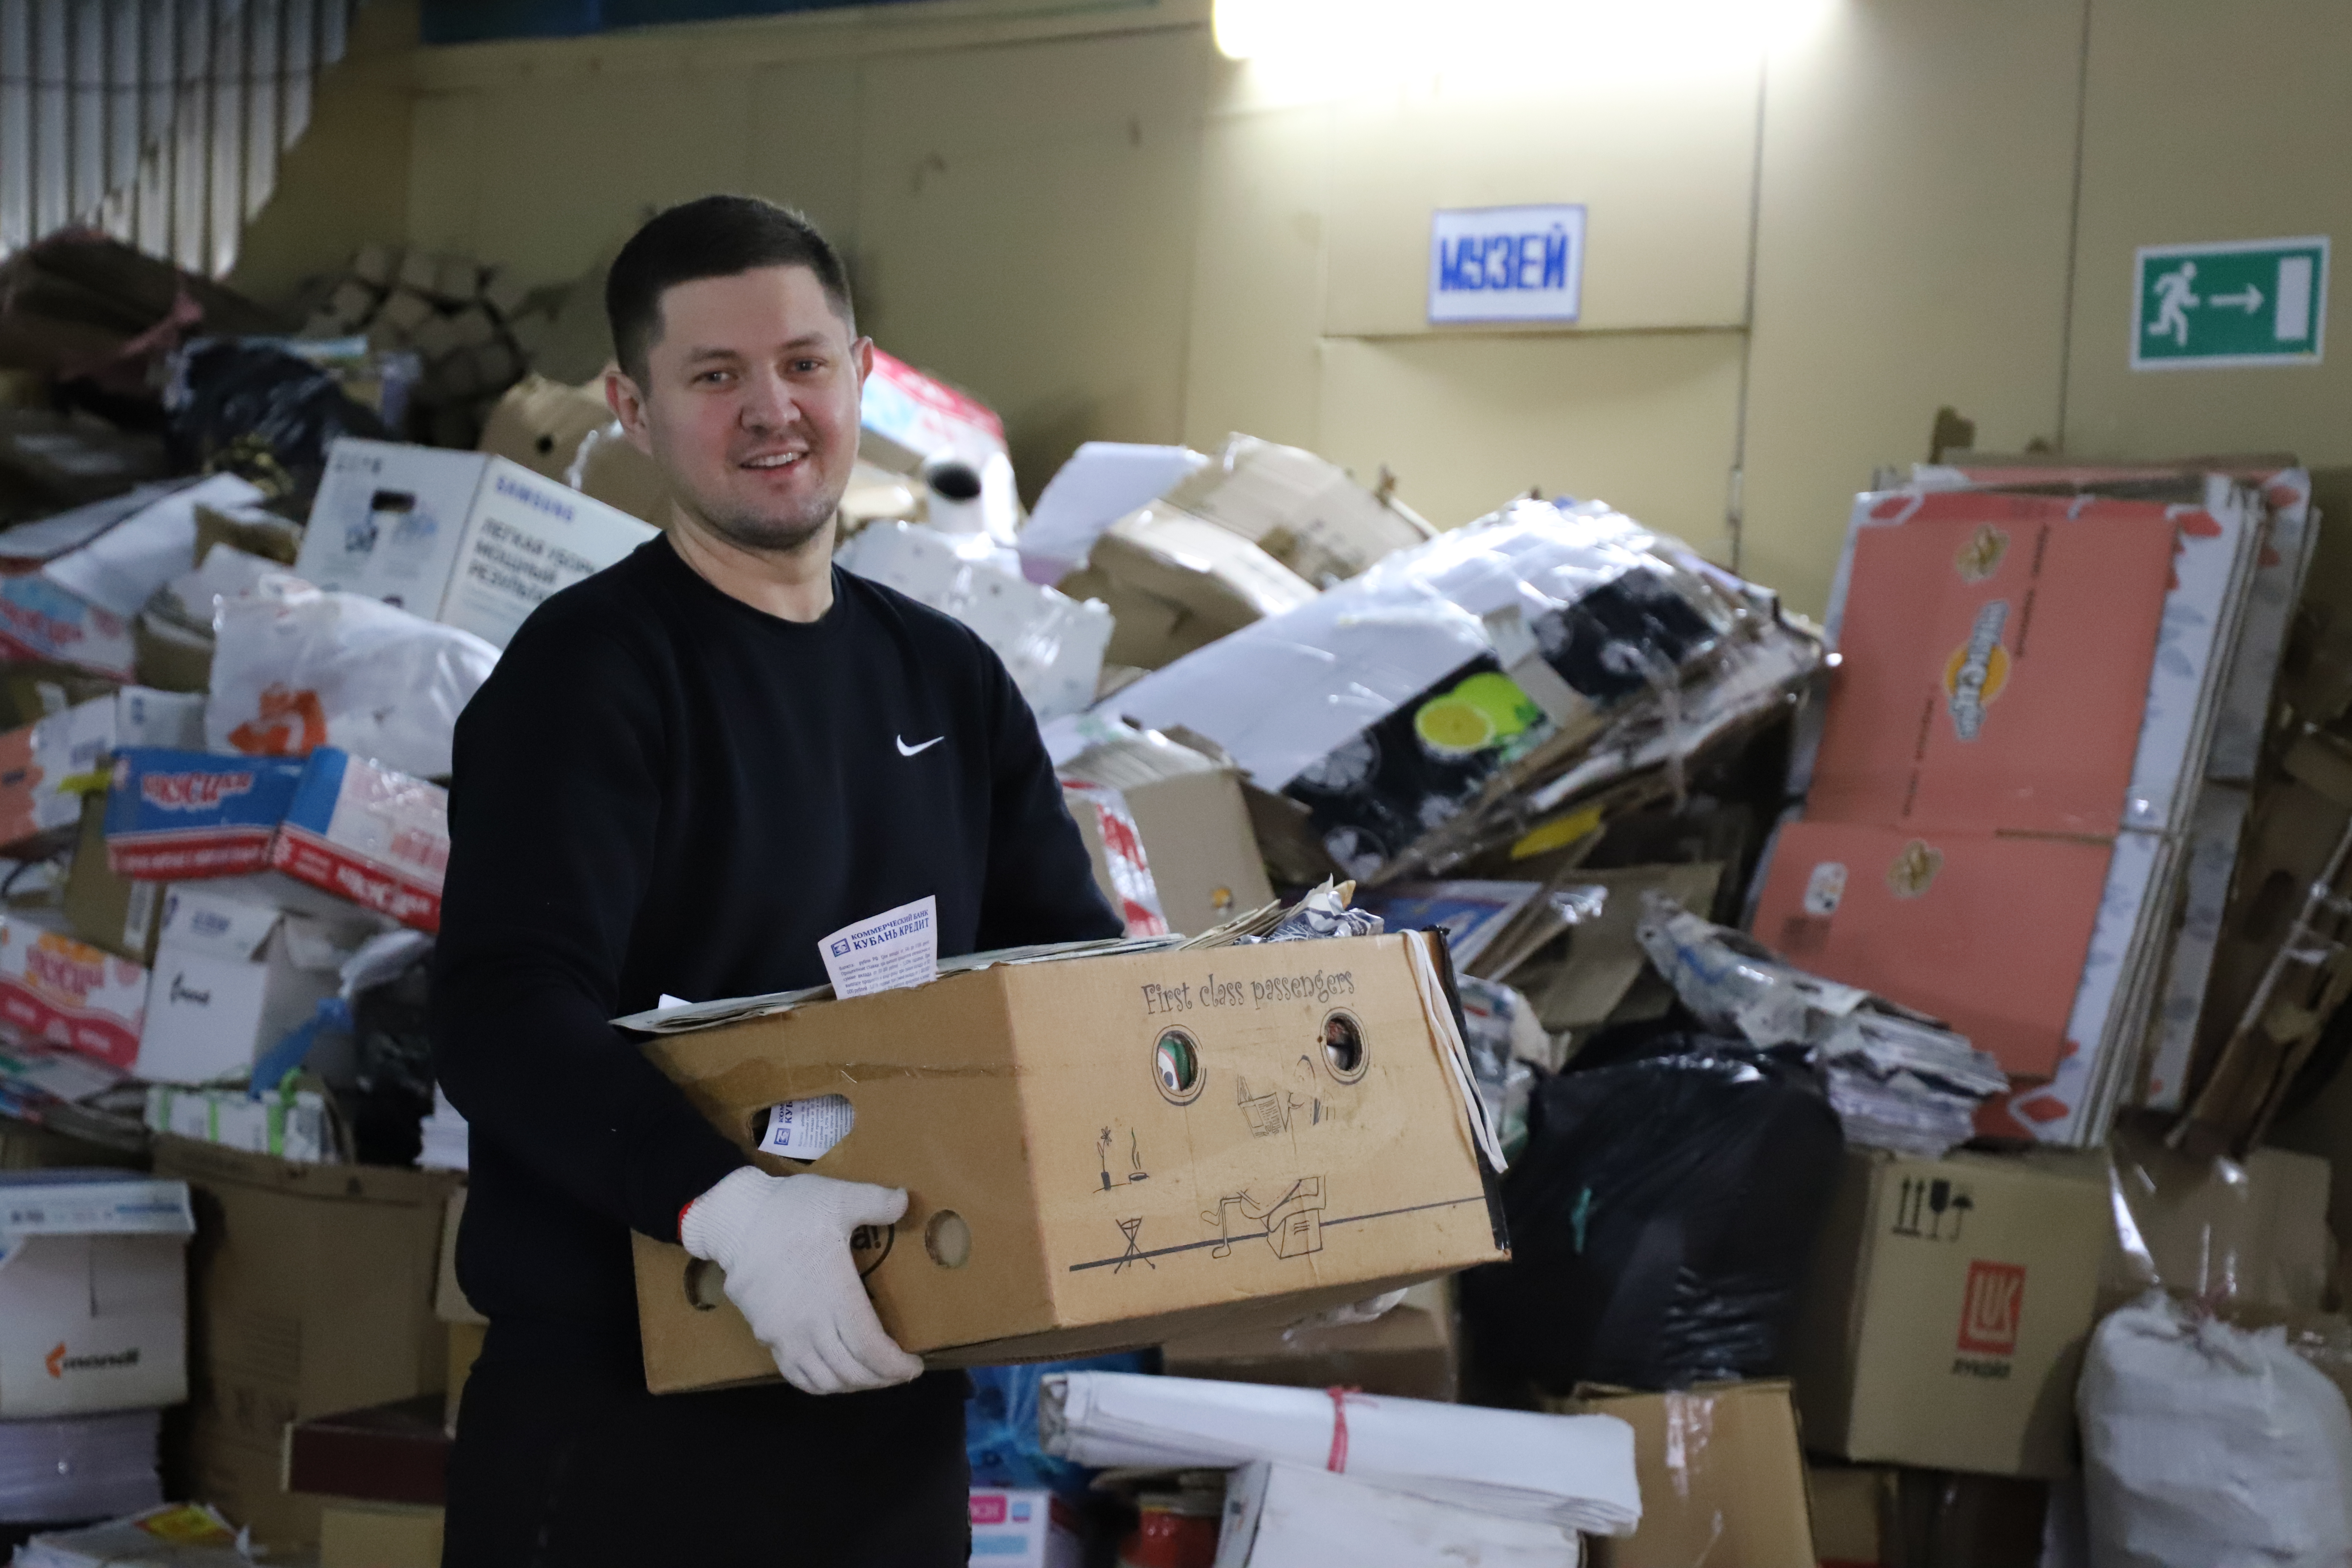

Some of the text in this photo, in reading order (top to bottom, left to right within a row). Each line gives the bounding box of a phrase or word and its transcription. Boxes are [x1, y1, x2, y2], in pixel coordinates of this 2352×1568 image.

[1440, 223, 1567, 290] МУЗЕЙ
[496, 475, 576, 521] SAMSUNG
[851, 910, 928, 940] КОММЕРЧЕСКИЙ БАНК
[853, 929, 897, 950] КУБАНЬ
[899, 918, 929, 936] КРЕДИТ
[1141, 969, 1355, 1015] First class passengers
